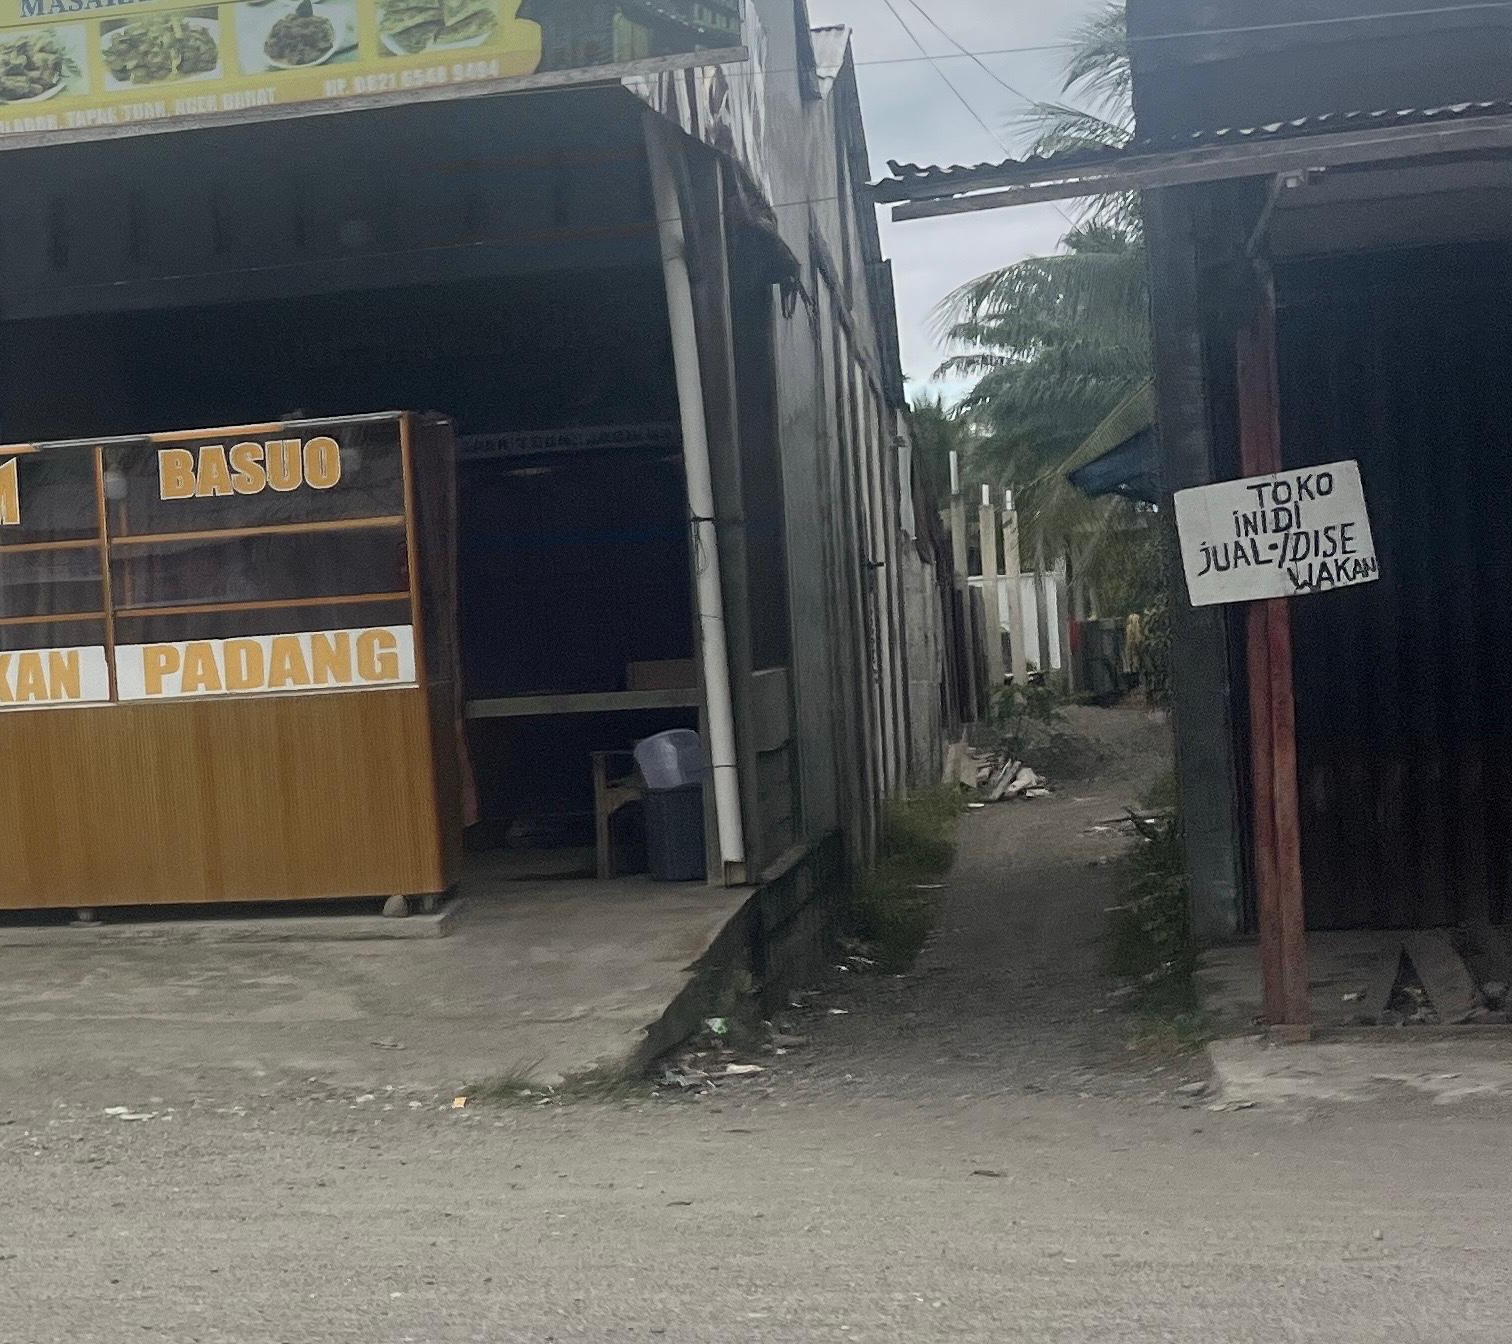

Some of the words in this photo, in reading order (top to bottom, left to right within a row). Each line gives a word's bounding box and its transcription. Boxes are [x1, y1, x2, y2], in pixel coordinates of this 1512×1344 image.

[157, 436, 342, 501] BASUO
[1246, 471, 1334, 508] TOKO
[1286, 556, 1377, 592] WAKAN
[142, 628, 400, 696] PADANG
